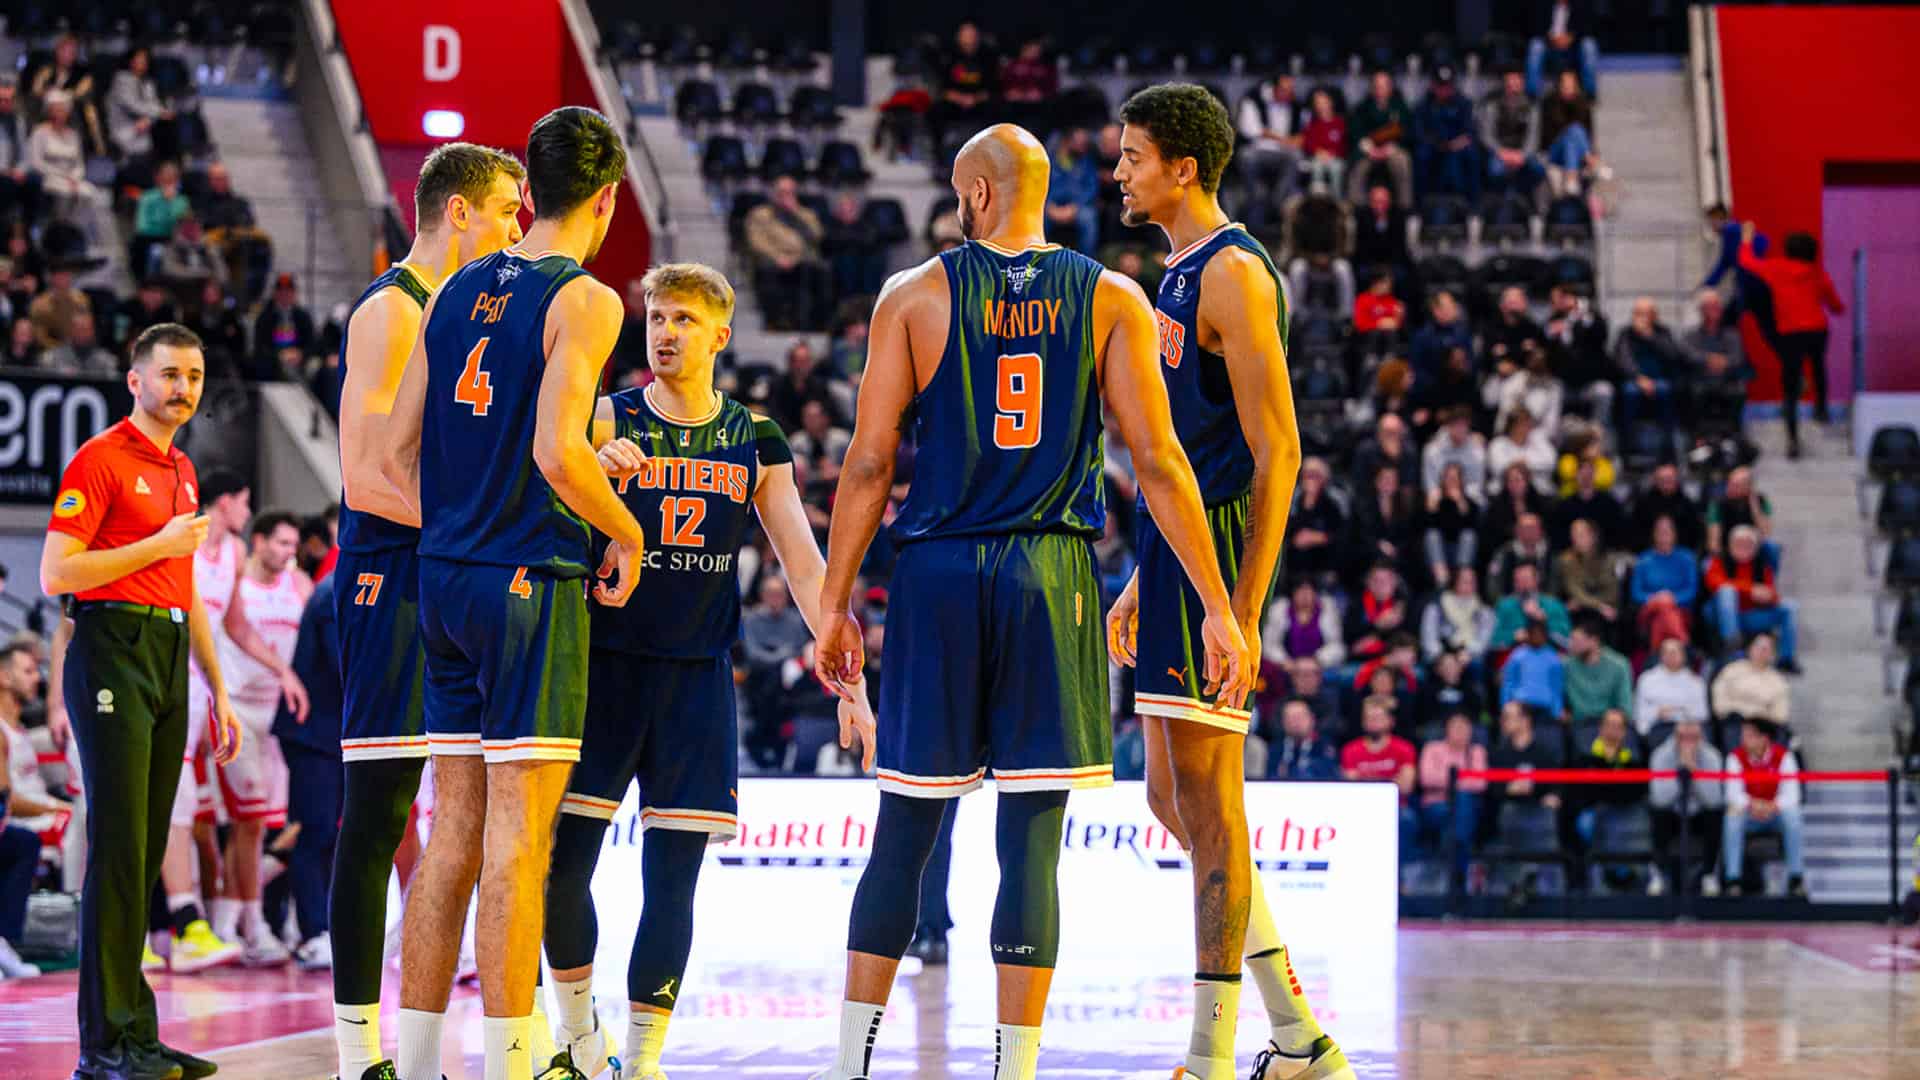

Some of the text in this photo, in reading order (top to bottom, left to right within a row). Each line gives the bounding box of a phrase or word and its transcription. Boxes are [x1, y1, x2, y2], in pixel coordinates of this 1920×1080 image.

[422, 24, 462, 82] D
[455, 337, 493, 416] 4
[993, 353, 1043, 449] 9
[660, 496, 707, 547] 12
[508, 566, 533, 600] 4
[670, 552, 732, 573] SPORT
[354, 573, 384, 606] 77
